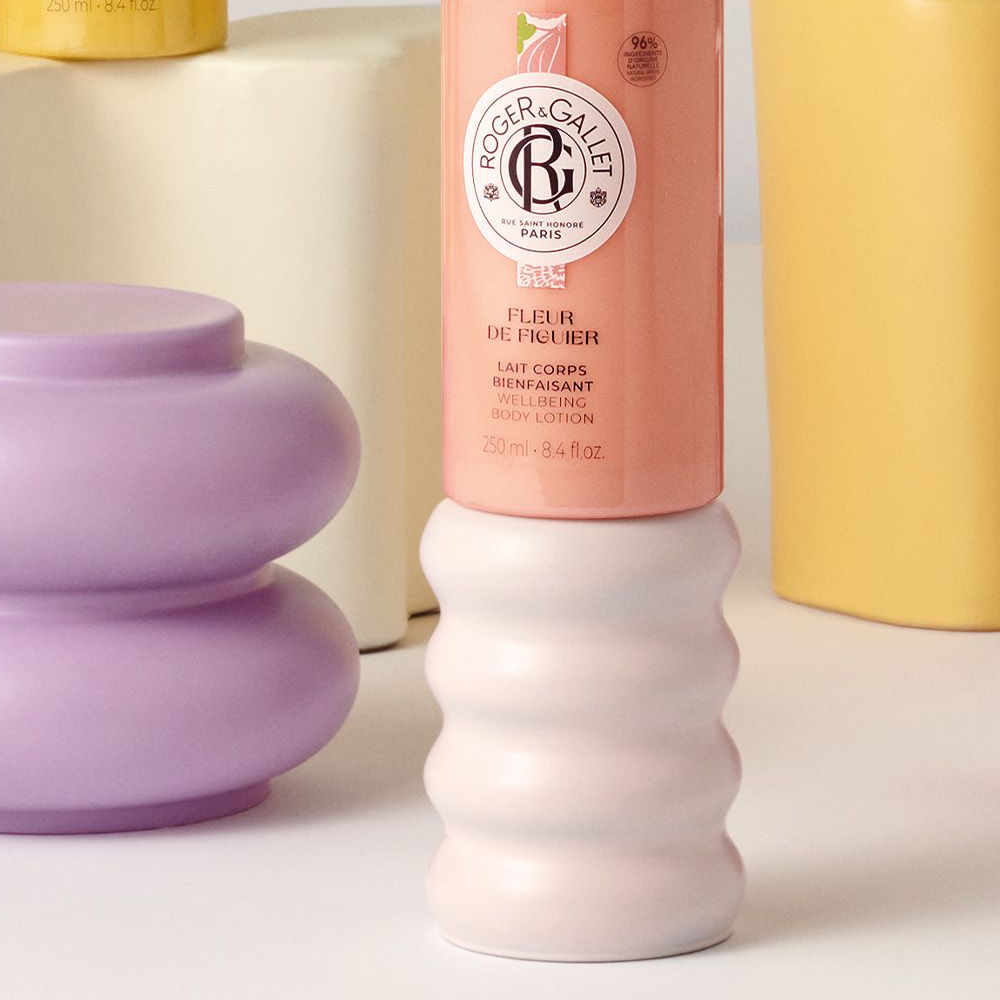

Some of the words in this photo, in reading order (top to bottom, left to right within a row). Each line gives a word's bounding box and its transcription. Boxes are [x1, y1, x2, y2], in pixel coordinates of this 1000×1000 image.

[631, 35, 658, 50] 96%
[501, 218, 517, 226] RUE
[519, 219, 544, 227] SAINT
[546, 219, 584, 229] HONORÉ
[521, 228, 562, 240] PARIS
[508, 307, 574, 325] FLEUR
[487, 325, 511, 342] DE
[518, 328, 599, 346] FIGUIER
[498, 361, 528, 374] LAIT
[533, 363, 588, 376] CORPS
[492, 376, 594, 392] BIENFAISANT
[497, 393, 587, 409] WELLBEING
[491, 408, 530, 422] BODY
[536, 412, 594, 424] LOTION
[482, 435, 505, 456] 250
[509, 440, 529, 457] ml
[541, 441, 566, 459] 8.4
